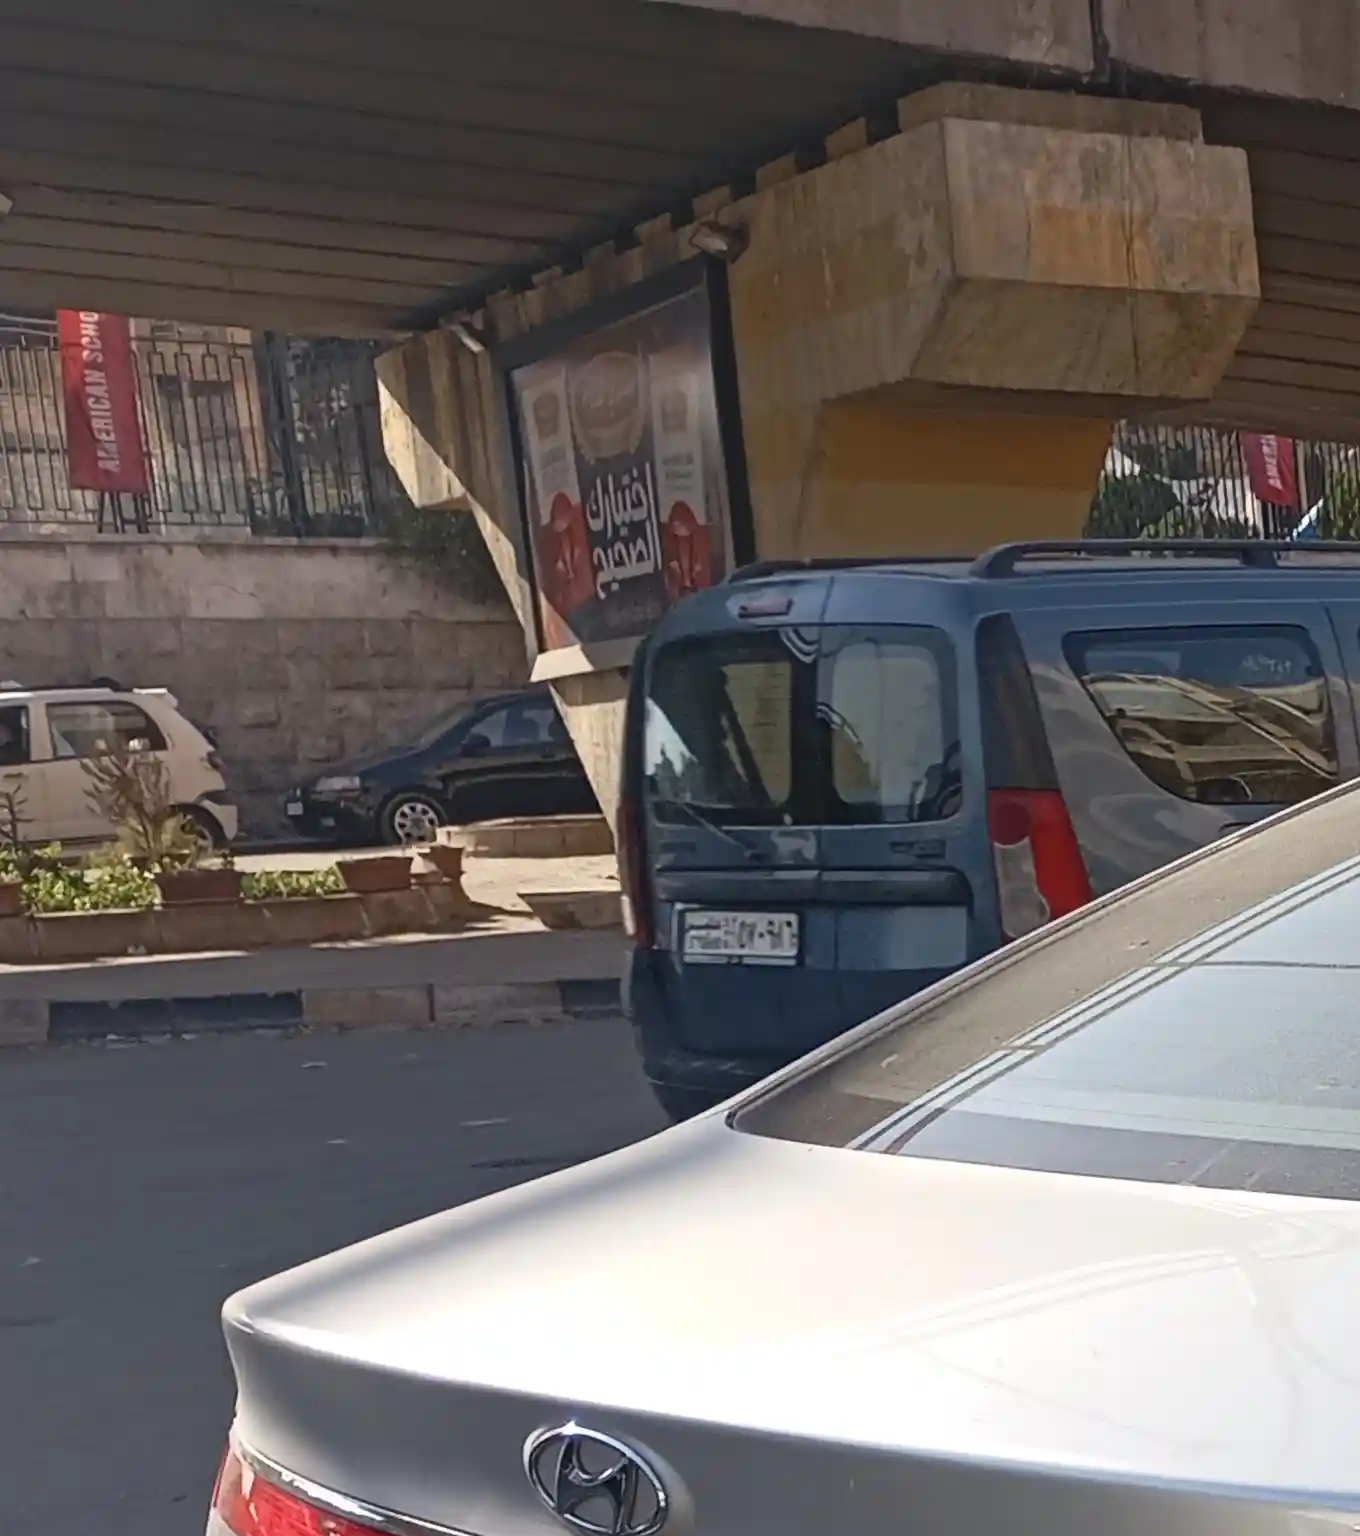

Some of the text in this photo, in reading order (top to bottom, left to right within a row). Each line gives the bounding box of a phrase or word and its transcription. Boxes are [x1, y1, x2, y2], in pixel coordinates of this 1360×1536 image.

[84, 369, 120, 474] AMERICAN
[586, 461, 658, 539] اختيارك
[593, 518, 662, 600] الصحيح
